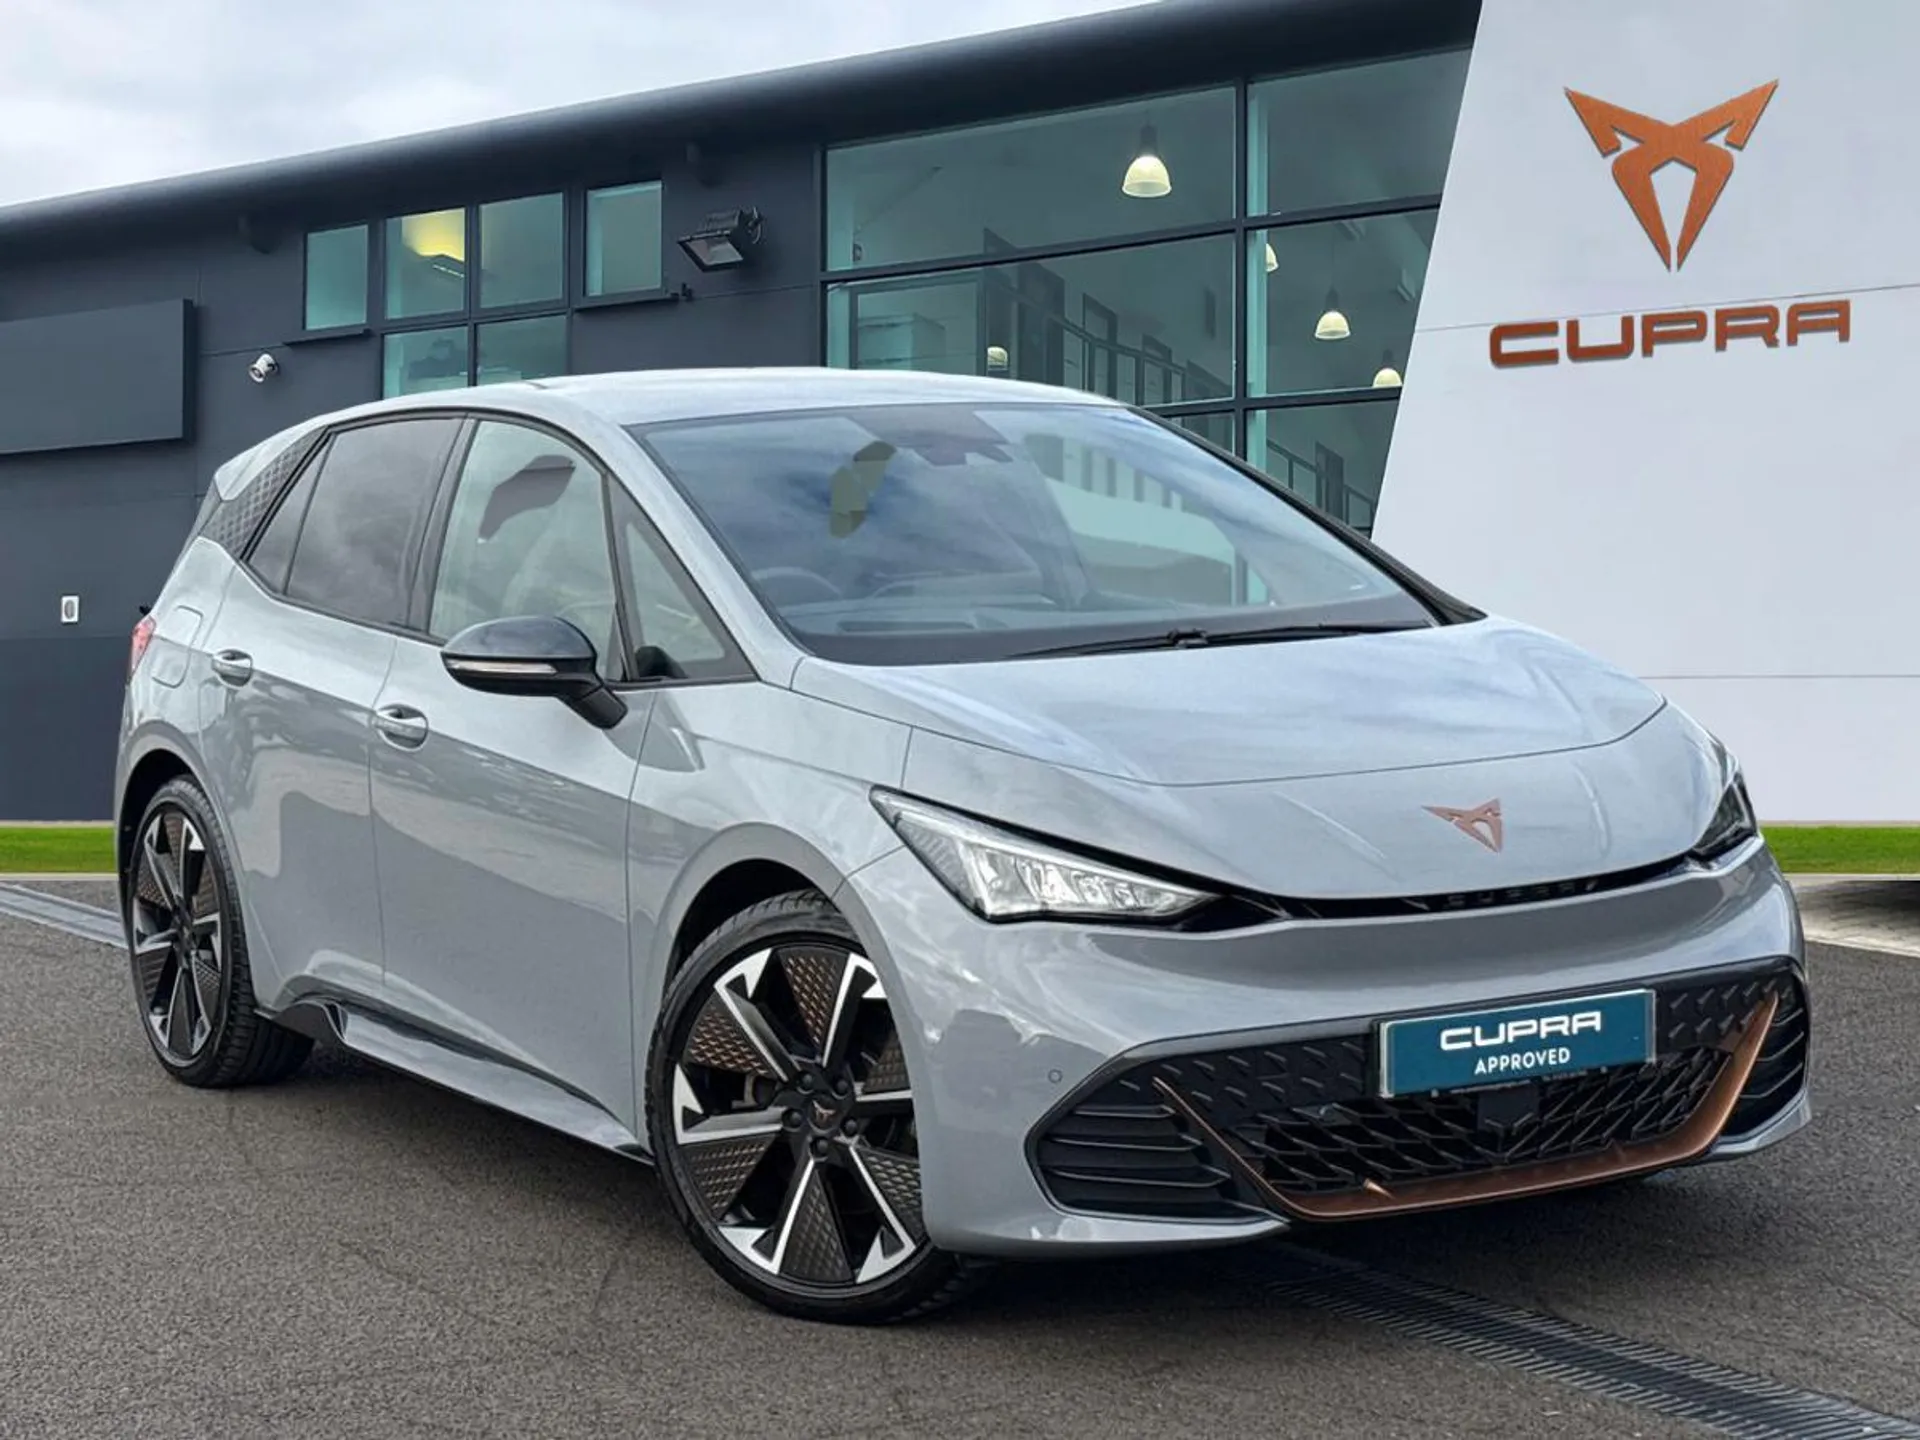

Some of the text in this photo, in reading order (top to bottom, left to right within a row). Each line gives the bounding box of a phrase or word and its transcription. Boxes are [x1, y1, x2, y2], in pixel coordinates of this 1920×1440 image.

[1489, 299, 1851, 369] CUPRA
[1440, 1011, 1601, 1051] CUPRA
[1474, 1047, 1571, 1076] APPROVED
